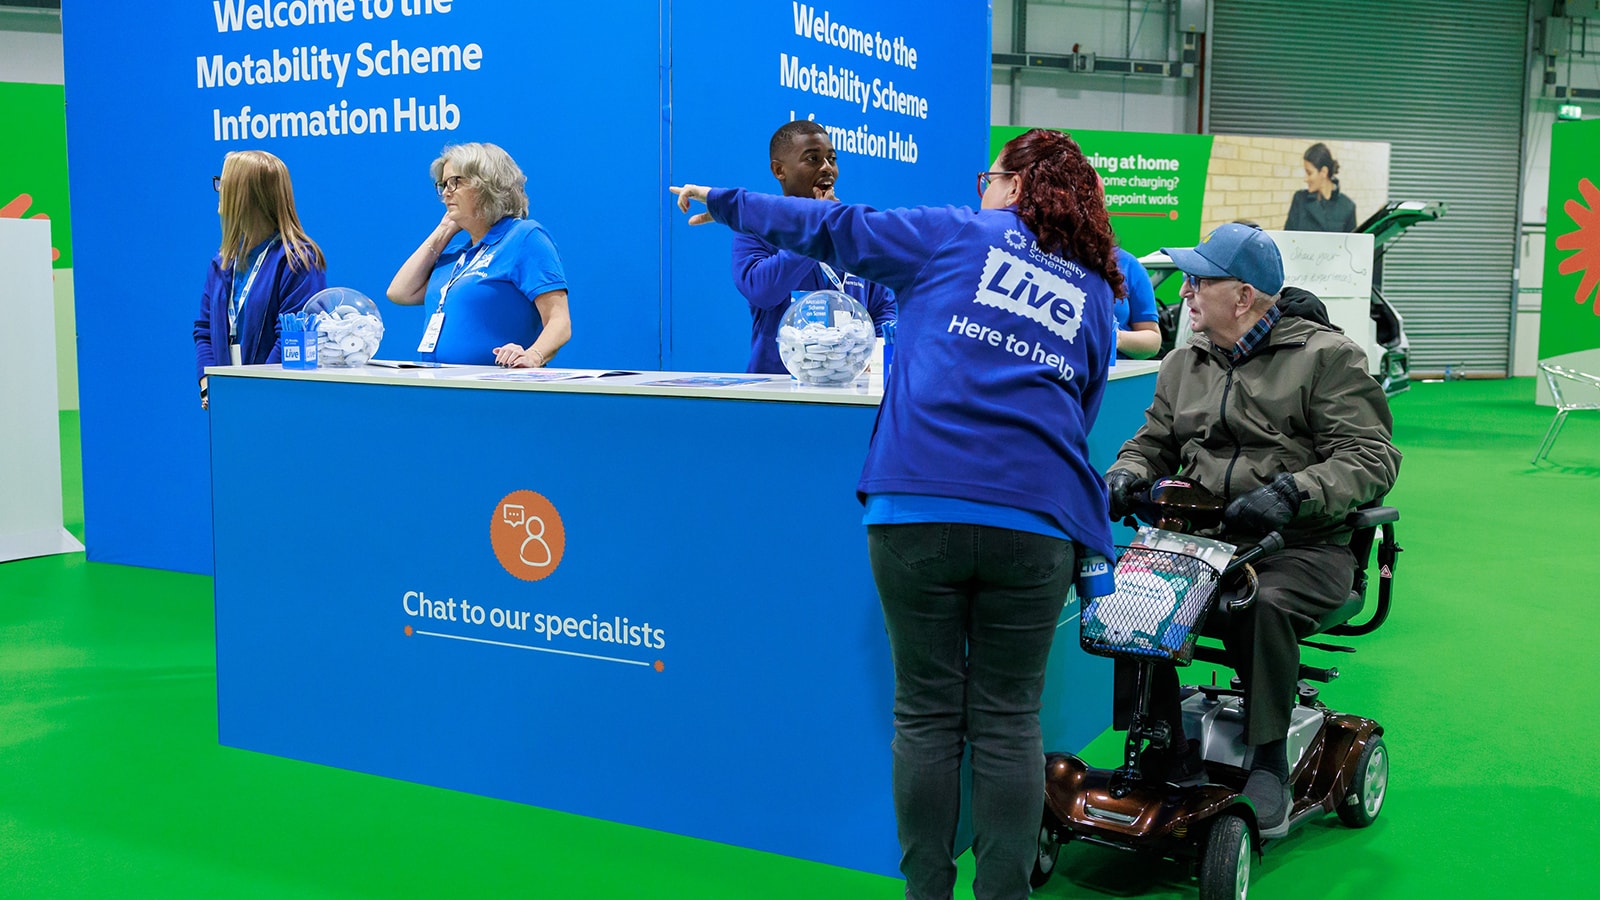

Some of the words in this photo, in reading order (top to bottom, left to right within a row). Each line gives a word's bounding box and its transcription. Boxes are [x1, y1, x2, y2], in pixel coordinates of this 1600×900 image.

[213, 0, 354, 33] Welcome
[360, 0, 394, 20] to
[792, 1, 873, 57] Welcome
[875, 31, 892, 62] to
[893, 36, 917, 70] the
[196, 45, 351, 88] Motability
[356, 39, 483, 78] Scheme
[780, 52, 871, 113] Motability
[872, 78, 928, 120] Scheme
[212, 99, 388, 141] Information
[393, 94, 461, 132] Hub
[888, 130, 918, 164] Hub
[1119, 156, 1136, 170] at
[1137, 154, 1180, 171] home
[1103, 177, 1126, 187] ome
[1128, 175, 1180, 191] charging?
[1105, 193, 1146, 206] gepoint
[1148, 193, 1179, 206] works
[1028, 250, 1073, 278] Scheme
[1030, 240, 1087, 279] Mtability
[986, 262, 1076, 326] Live
[285, 348, 299, 359] Live
[947, 314, 1003, 347] Here
[1005, 333, 1030, 357] to
[1031, 342, 1075, 382] help
[1080, 561, 1106, 574] Live
[402, 590, 457, 622] Chat
[460, 599, 486, 625] to
[489, 607, 531, 631] our
[534, 613, 666, 650] specialists
